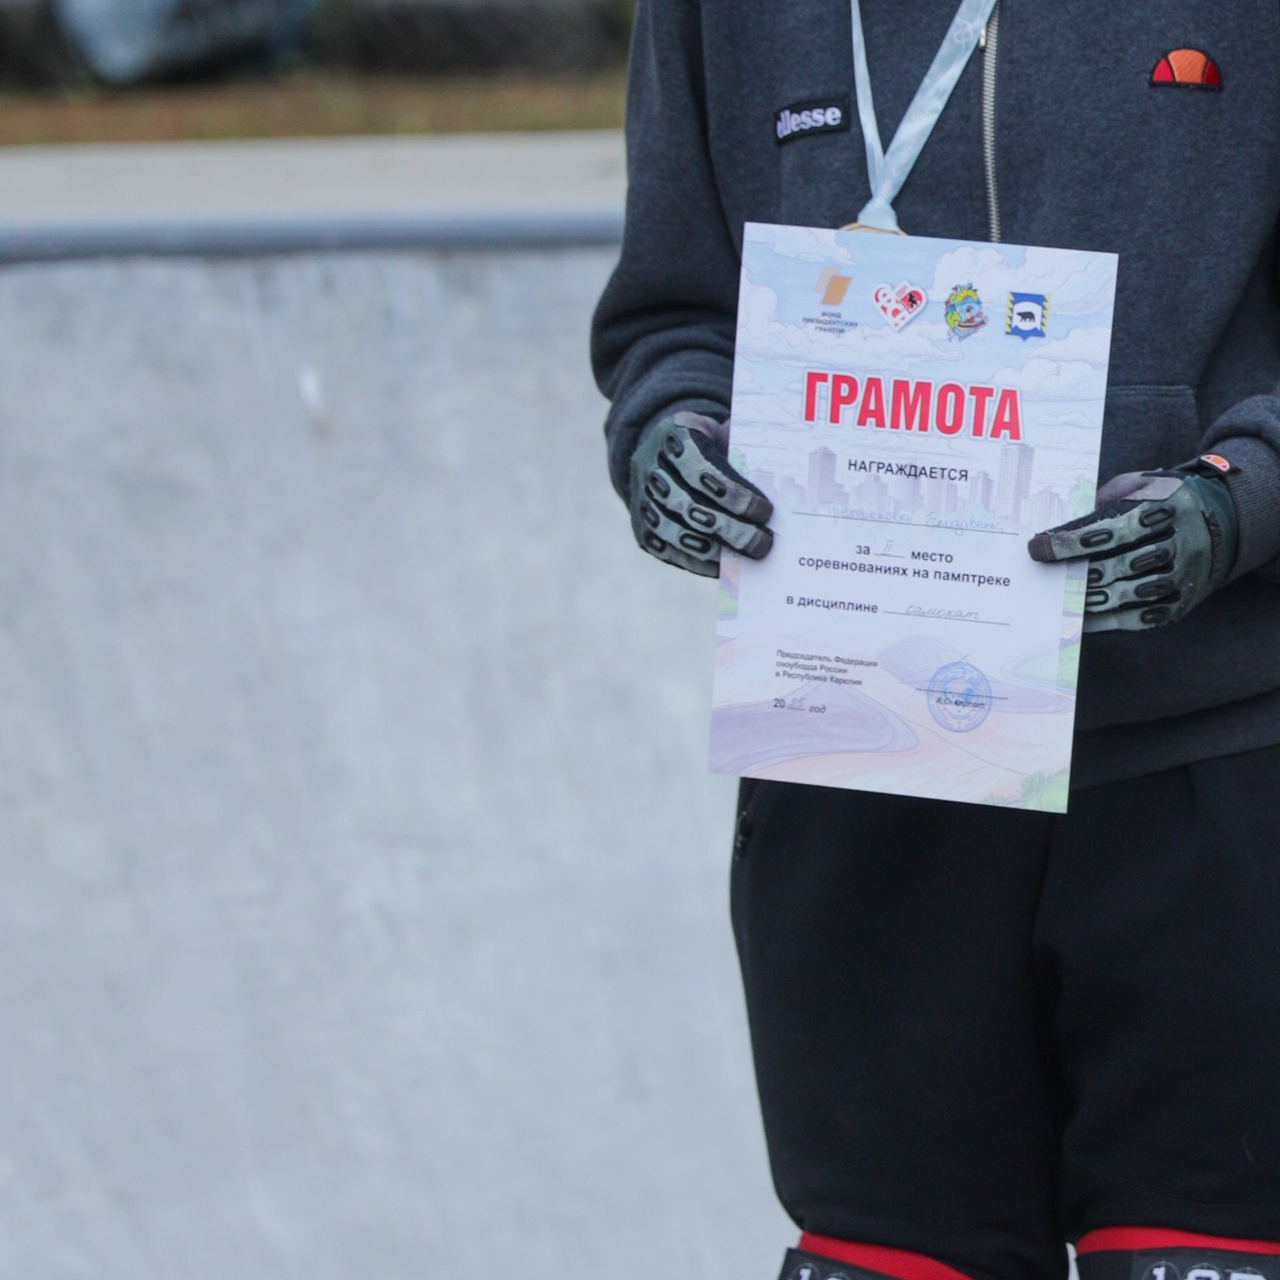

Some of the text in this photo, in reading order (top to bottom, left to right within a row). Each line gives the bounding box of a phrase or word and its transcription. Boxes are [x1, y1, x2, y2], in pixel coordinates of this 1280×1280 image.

[804, 371, 1022, 441] ГРАМОТА
[848, 459, 969, 481] НАГРАЖДАЕТСЯ
[855, 544, 871, 556] за
[910, 549, 954, 564] место
[798, 556, 1011, 588] соревнованиях на памптреке
[786, 595, 879, 614] в дисциплине
[776, 649, 832, 663] Председатель
[820, 664, 848, 674] России
[773, 698, 786, 709] 20
